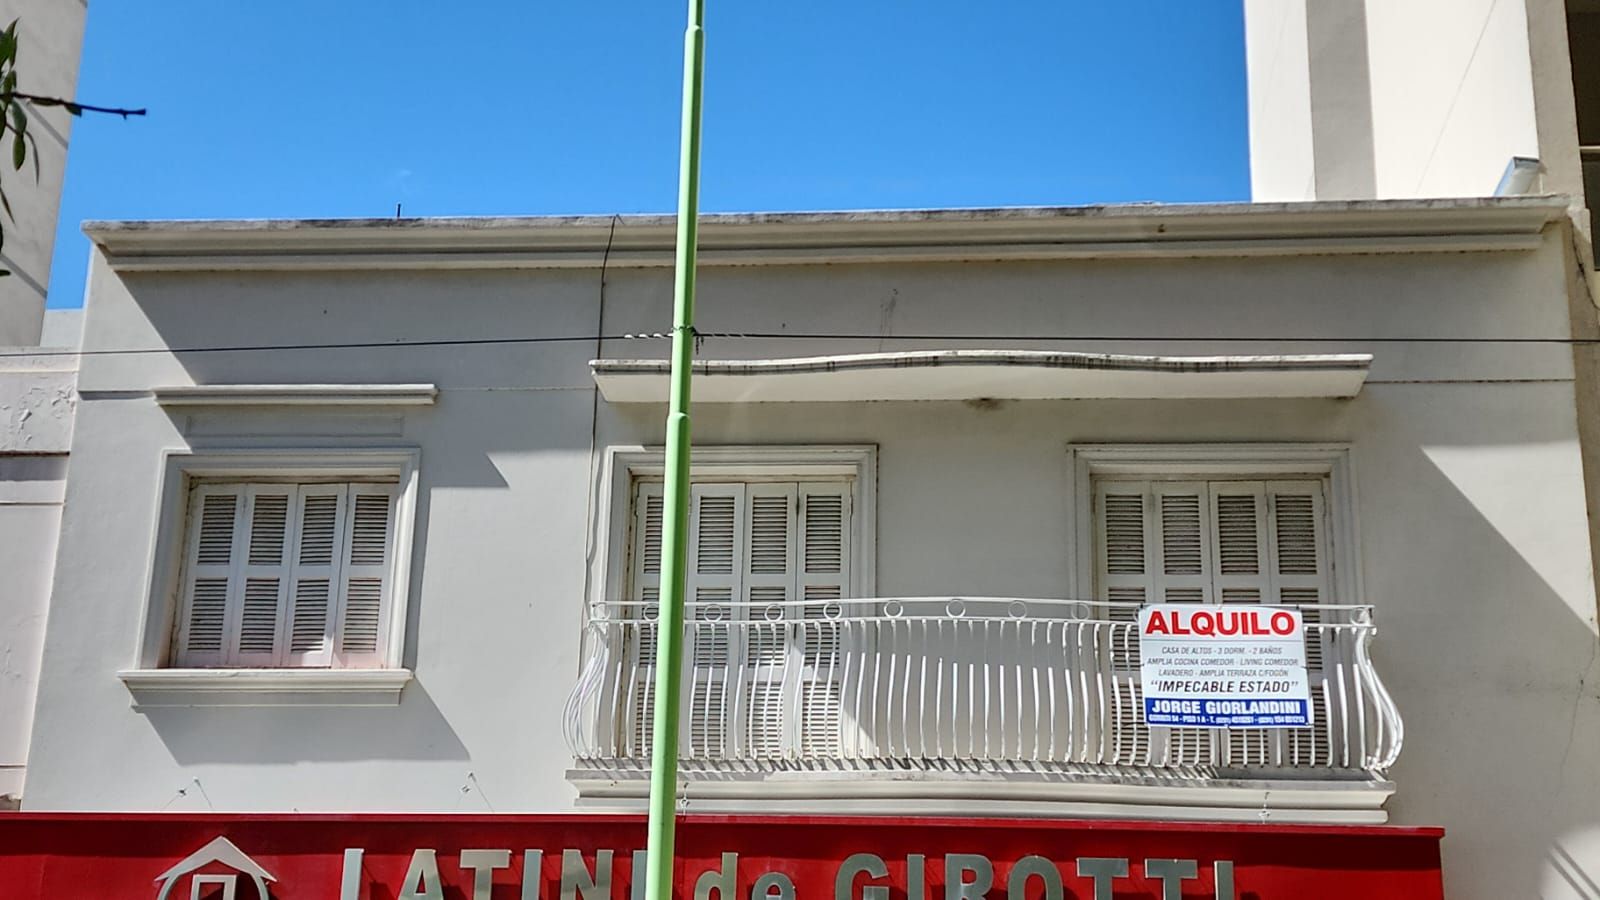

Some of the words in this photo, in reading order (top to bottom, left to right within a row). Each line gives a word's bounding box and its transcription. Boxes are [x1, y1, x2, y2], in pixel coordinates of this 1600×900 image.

[1145, 610, 1295, 637] ALQUILO
[1161, 646, 1179, 654] CASA
[1181, 646, 1190, 655] DE
[1191, 647, 1213, 655] ALTOS
[1217, 647, 1223, 655] 3
[1252, 647, 1258, 655] 2
[1258, 645, 1283, 655] BAÑOS
[1200, 658, 1235, 666] COMEDOR
[1239, 658, 1263, 666] LIVING
[1264, 658, 1299, 666] COMEDOR
[1199, 669, 1225, 677] AMPLIA
[1226, 669, 1257, 677] TERRAZA
[1151, 700, 1202, 714] JORGE
[1205, 701, 1301, 715] GIORLANDINI
[694, 852, 797, 900] de
[834, 853, 1236, 900] GIROTTI
